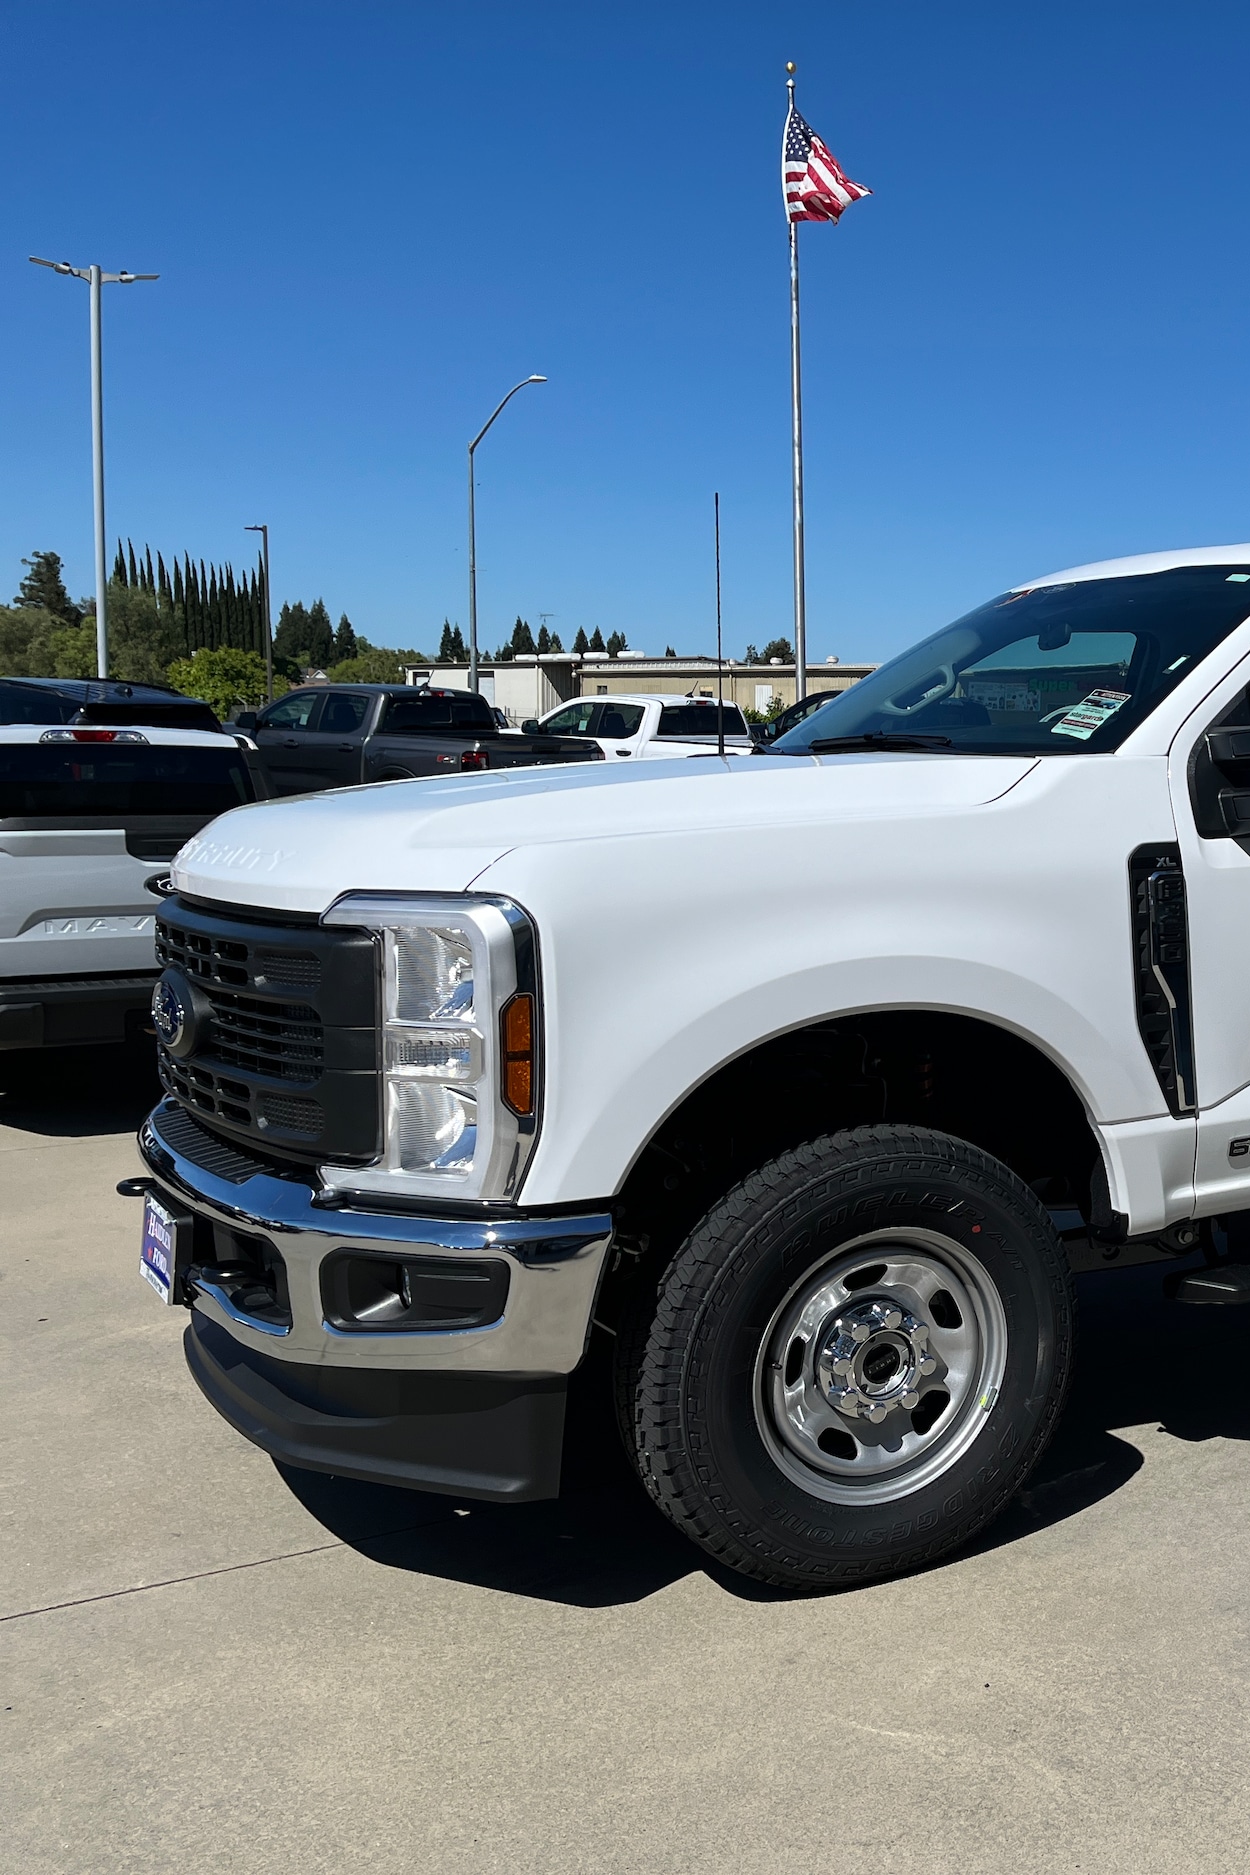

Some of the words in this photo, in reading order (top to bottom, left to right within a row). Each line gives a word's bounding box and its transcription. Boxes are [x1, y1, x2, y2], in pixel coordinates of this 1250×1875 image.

[1156, 857, 1176, 867] XL
[45, 916, 150, 934] MAV
[781, 1189, 986, 1271] DUELER
[761, 1422, 1020, 1549] BRIDGESTONE
